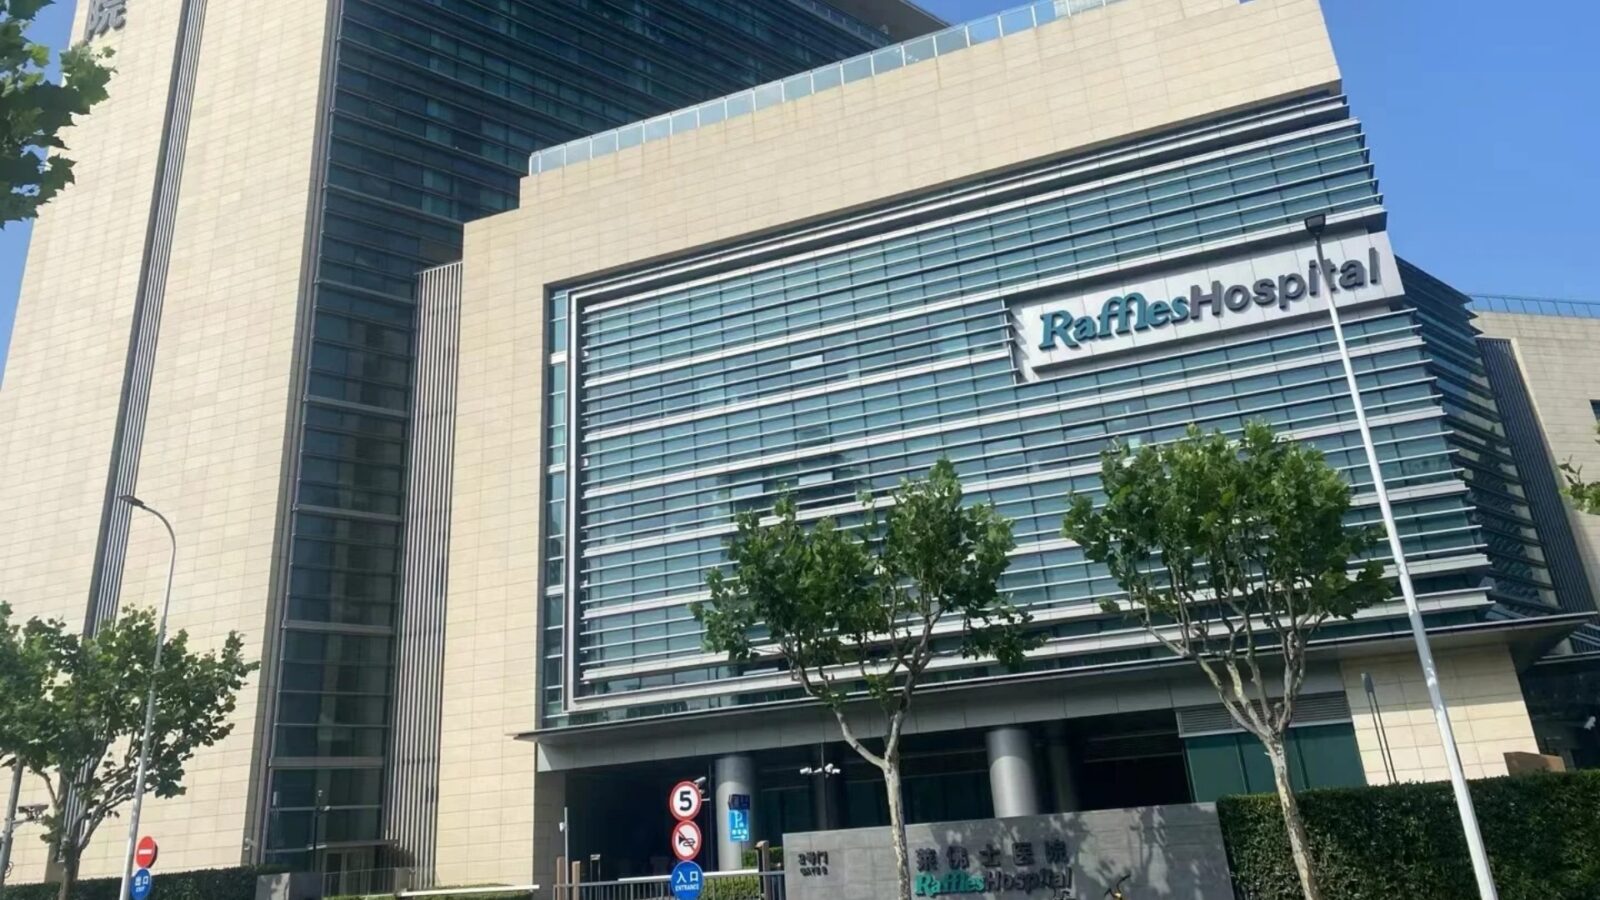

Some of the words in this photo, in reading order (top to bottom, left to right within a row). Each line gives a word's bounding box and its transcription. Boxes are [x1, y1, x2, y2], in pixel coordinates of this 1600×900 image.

[680, 791, 692, 811] 5
[914, 837, 1071, 872] 莱佛士医院
[135, 875, 149, 886] 出口
[676, 871, 699, 884] 入口
[675, 883, 699, 892] ENTRANCE
